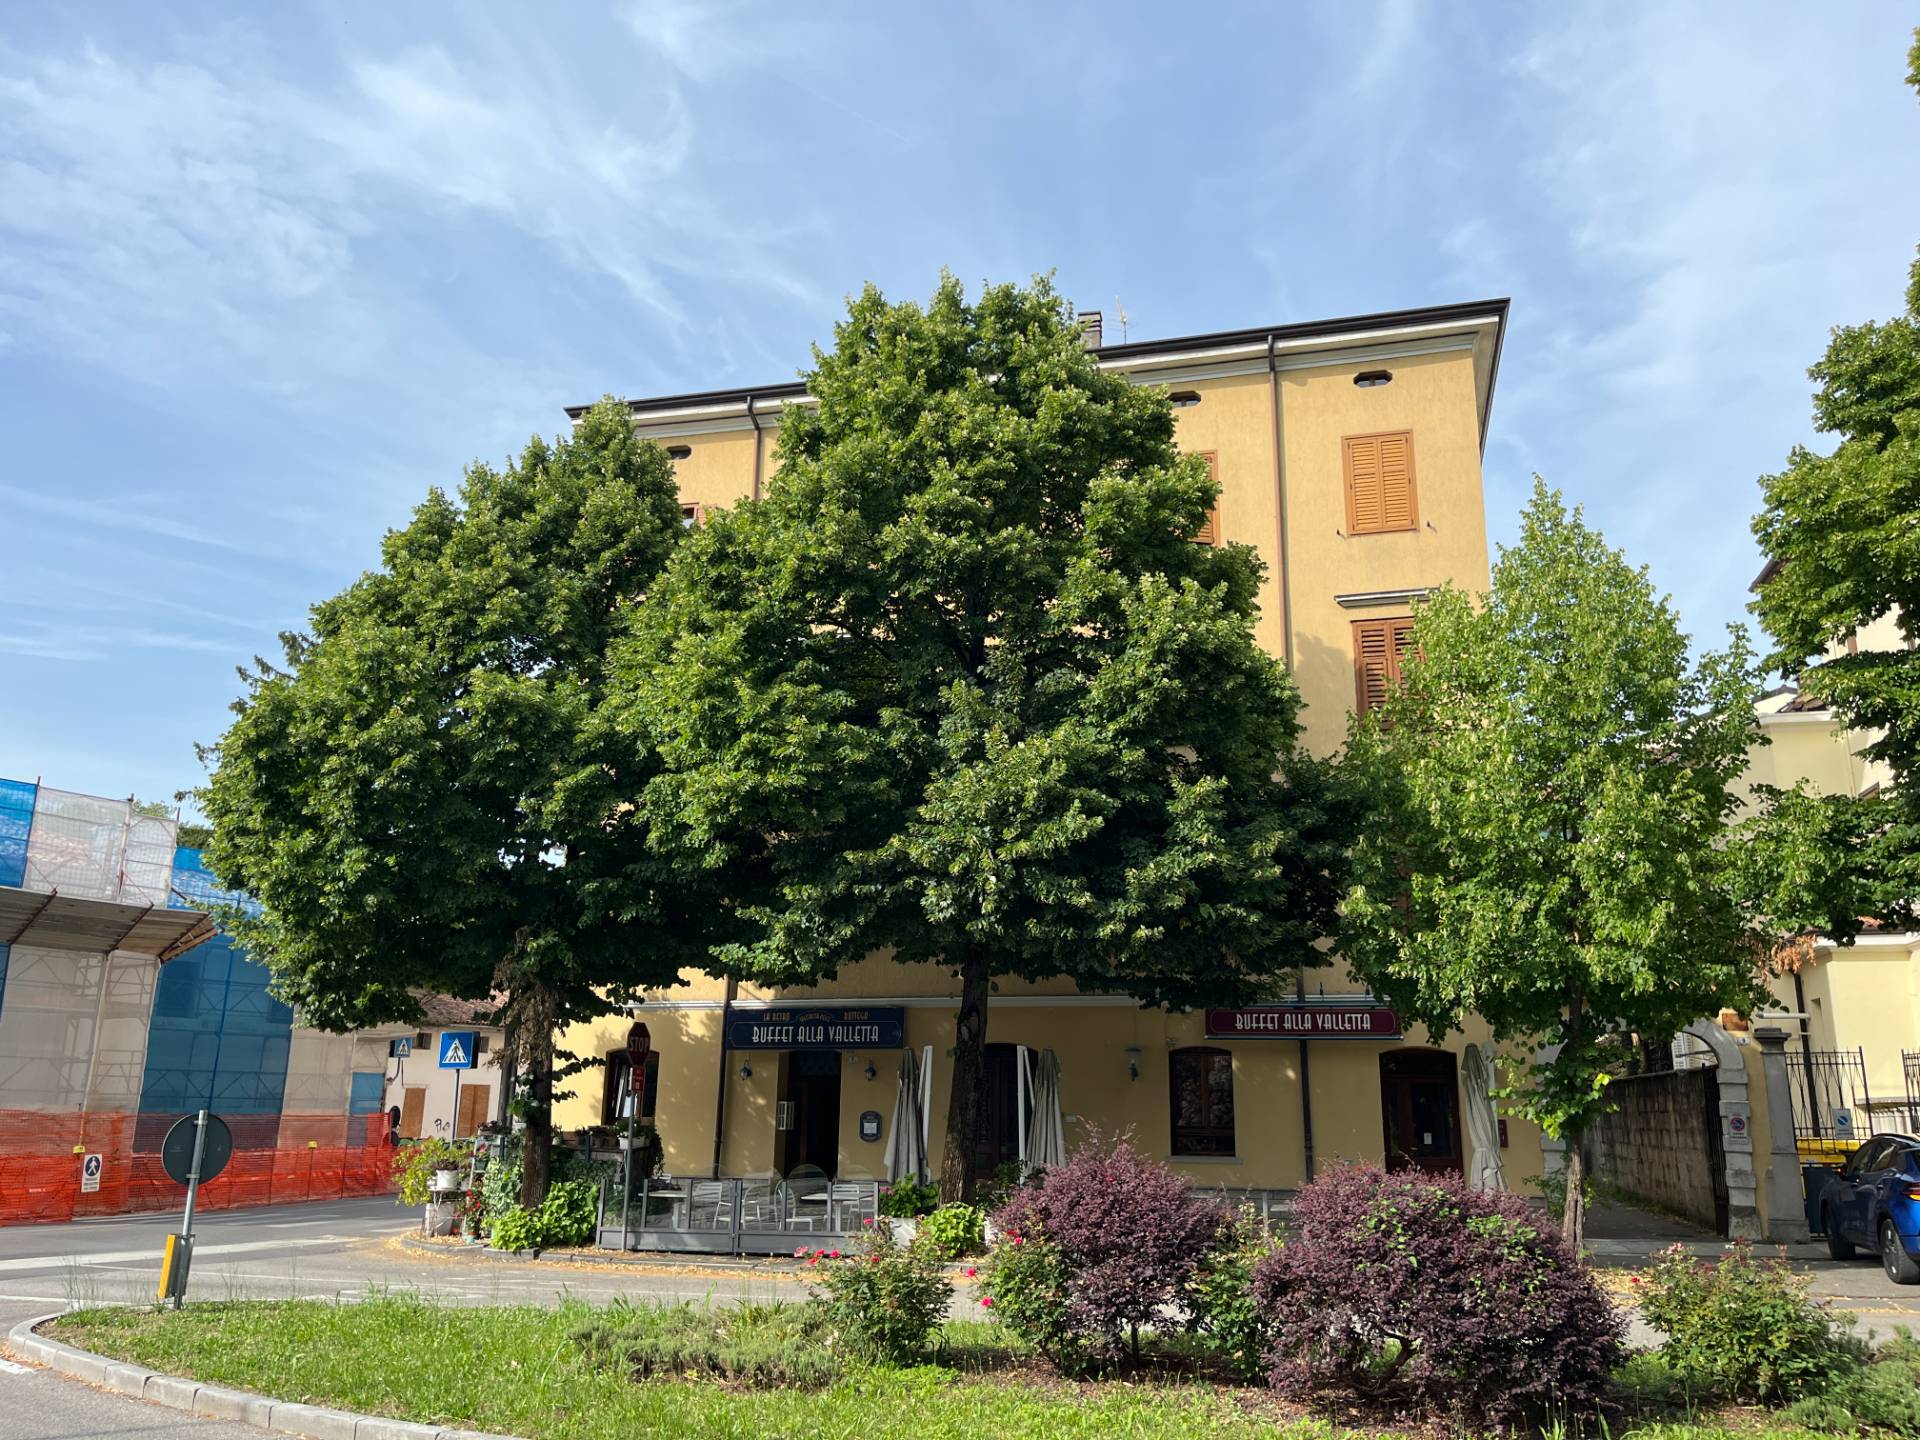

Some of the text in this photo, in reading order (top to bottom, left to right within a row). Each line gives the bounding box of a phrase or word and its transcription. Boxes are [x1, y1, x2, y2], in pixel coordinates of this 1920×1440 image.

[1235, 1013, 1371, 1030] BUFFET ALLA VALLETTA
[752, 1025, 879, 1043] BUFFET ALLA VALLETTA
[630, 1036, 649, 1052] STOP
